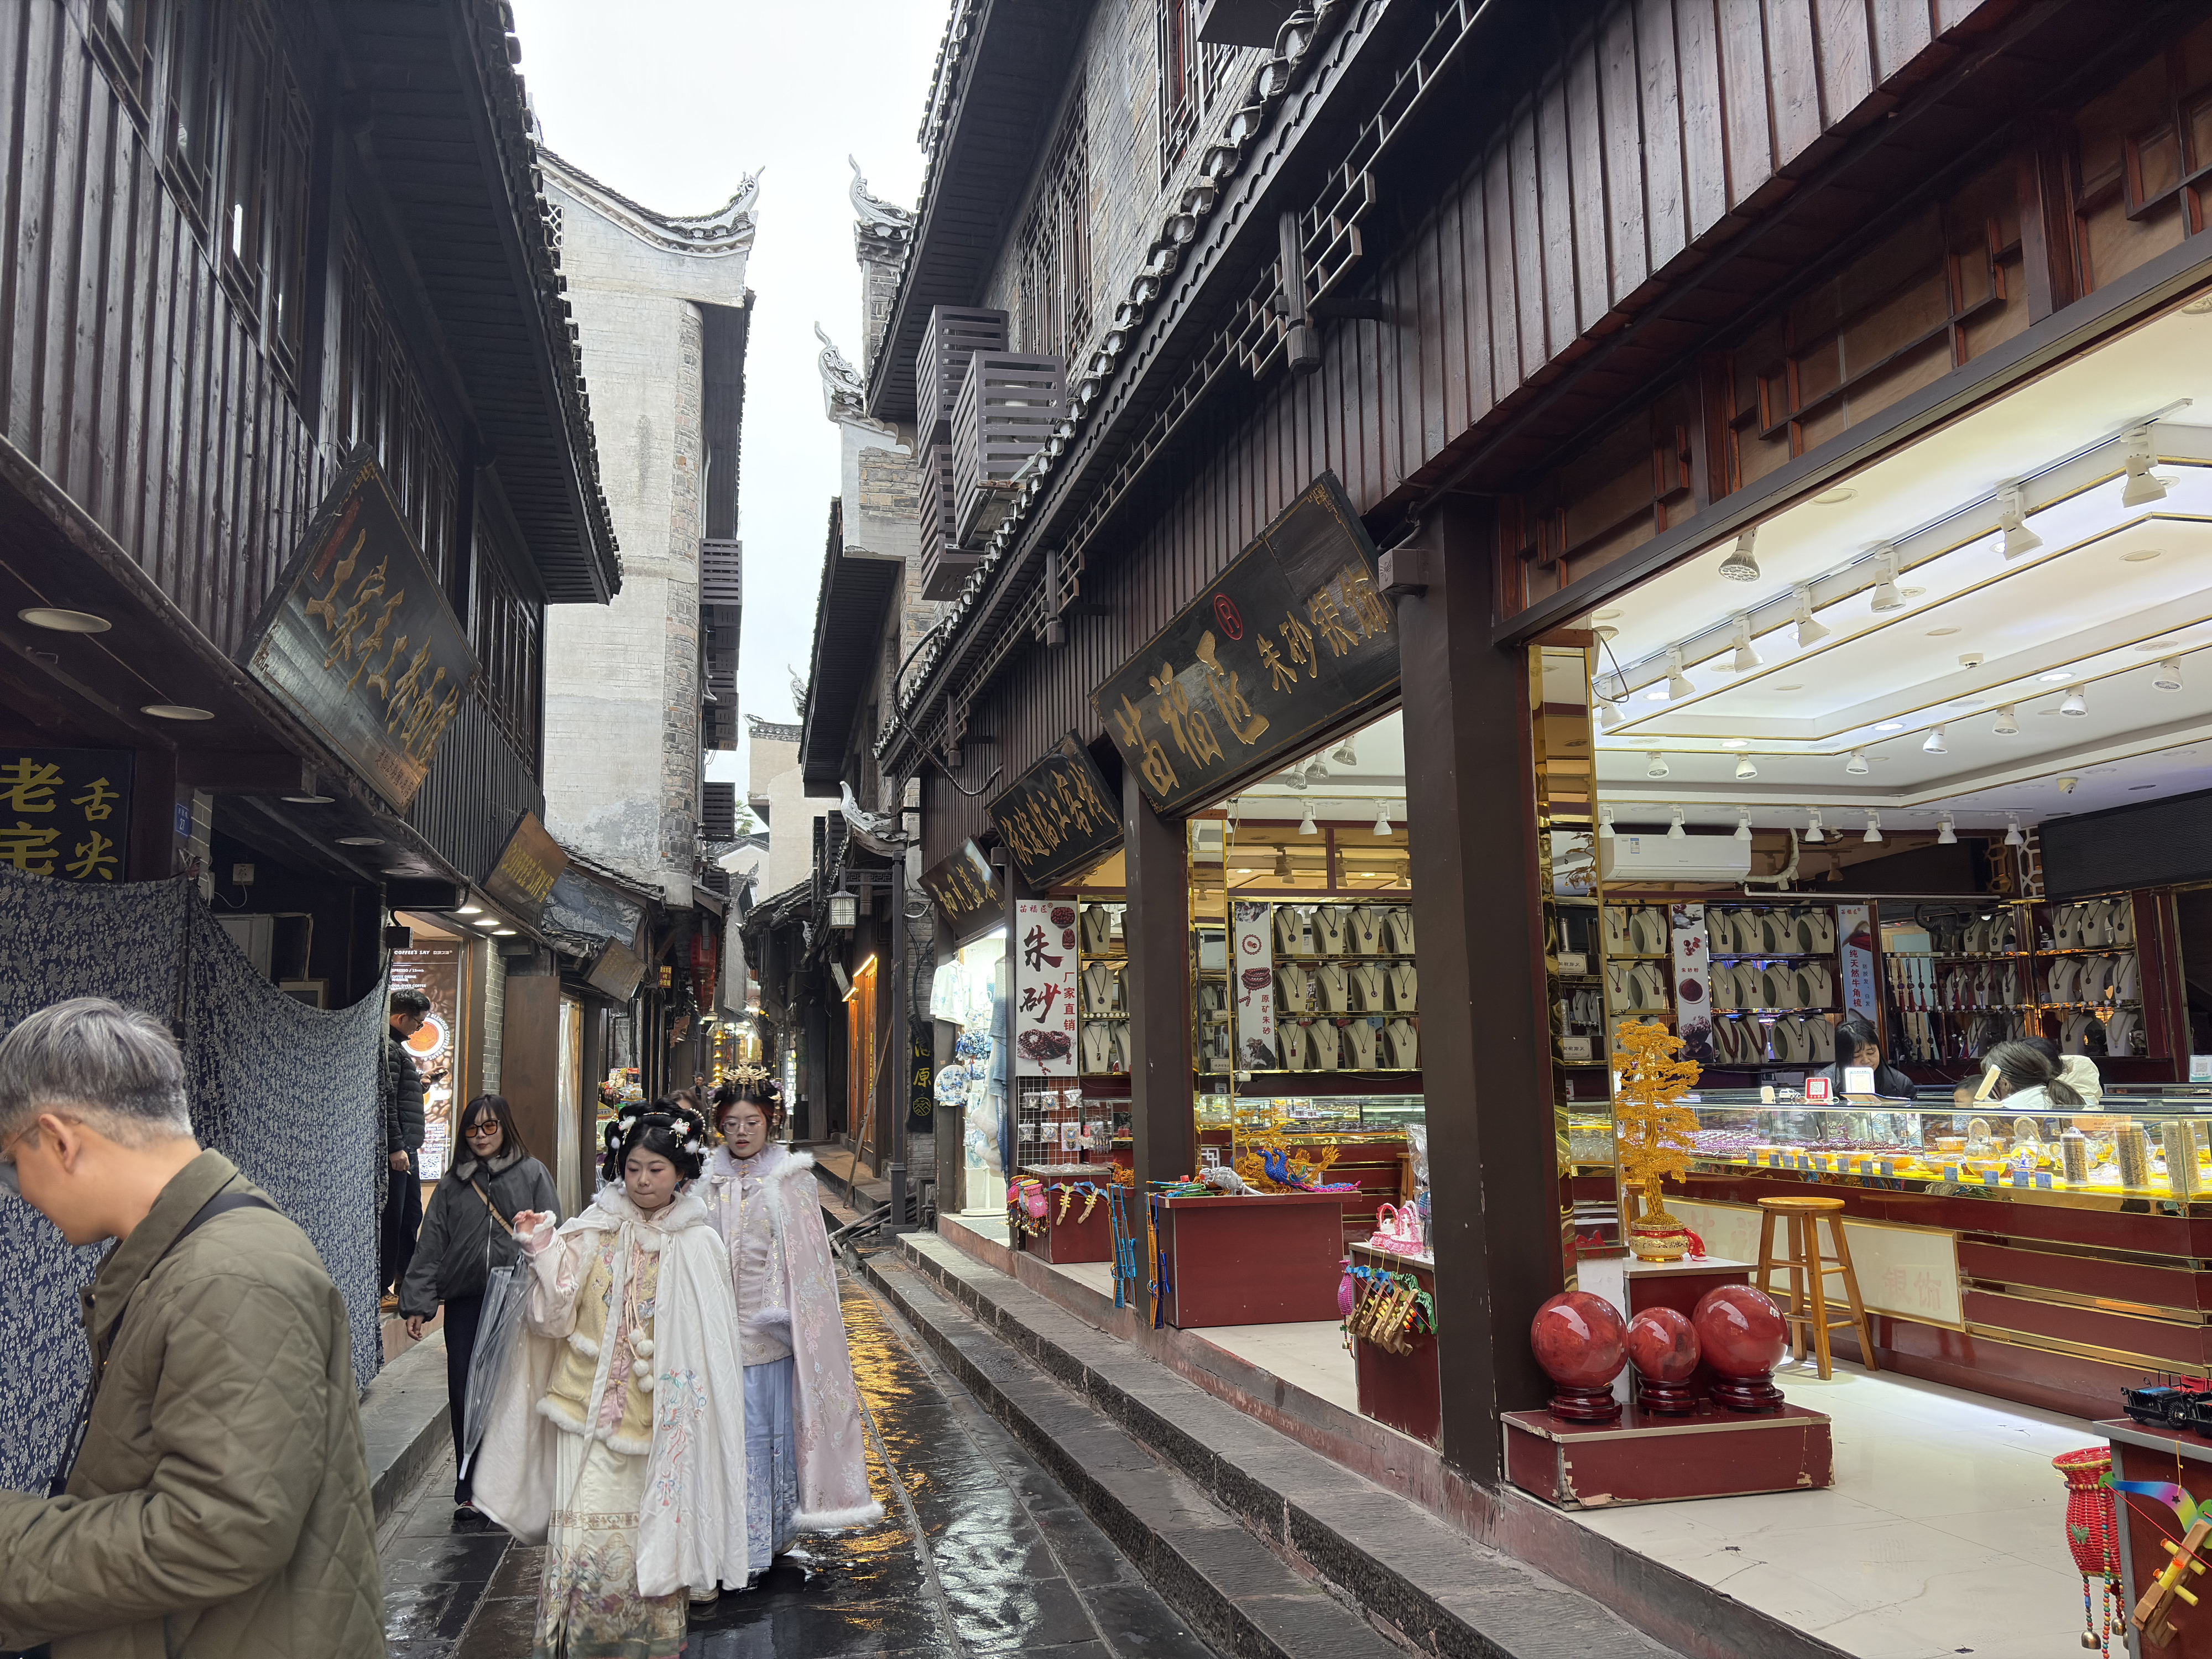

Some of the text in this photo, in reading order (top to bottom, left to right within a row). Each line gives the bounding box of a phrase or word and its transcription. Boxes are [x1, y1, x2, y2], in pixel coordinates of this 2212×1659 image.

[1256, 564, 1390, 695] 朱砂银饰
[1114, 629, 1270, 797] 苗福匠
[65, 777, 119, 880] 舌尖
[1000, 761, 1115, 867] 旅途临江客栈
[1019, 924, 1065, 1024] 朱砂
[1057, 972, 1070, 1032] 厂家直销
[1849, 949, 1863, 1007] 纯天然牛角梳
[1862, 963, 1871, 1007] 防脱发、白发
[431, 1014, 449, 1031] BLENDED
[1261, 994, 1271, 1035] 原矿朱砂
